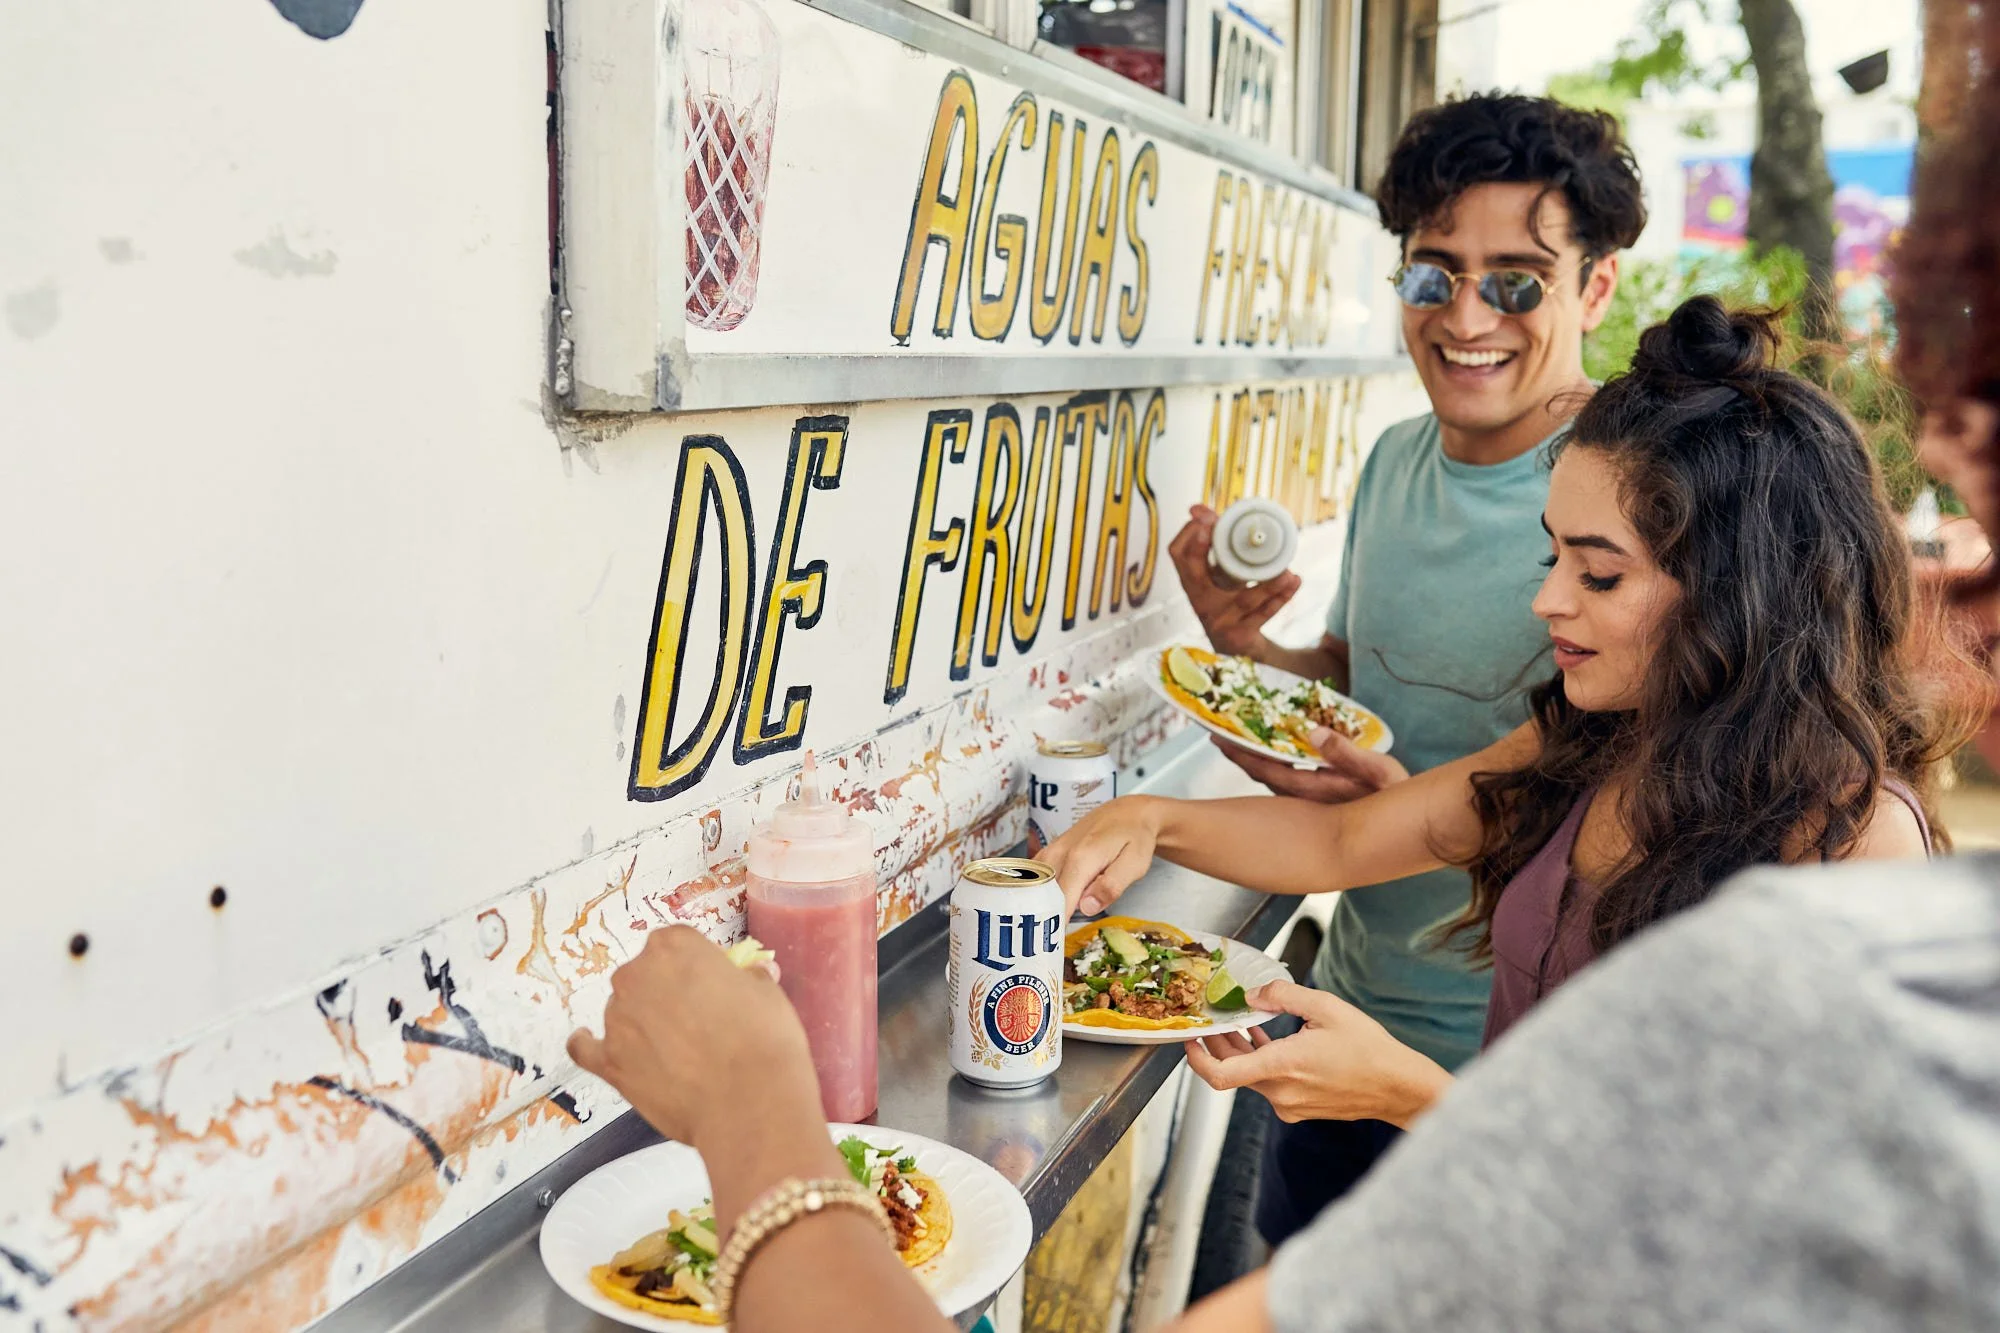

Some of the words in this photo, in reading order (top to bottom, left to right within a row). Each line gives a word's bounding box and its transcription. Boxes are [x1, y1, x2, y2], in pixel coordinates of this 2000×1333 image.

[890, 68, 1160, 346] AGUAS
[1195, 168, 1338, 350] FRESCAS
[627, 415, 849, 802] DE
[884, 386, 1166, 705] FRUTAS
[1028, 773, 1058, 812] te
[972, 908, 1060, 971] Lite
[987, 1001, 996, 1009] A
[990, 978, 1015, 999] FINE
[1018, 976, 1050, 1007] PILSNER
[1004, 1041, 1036, 1054] BEER
